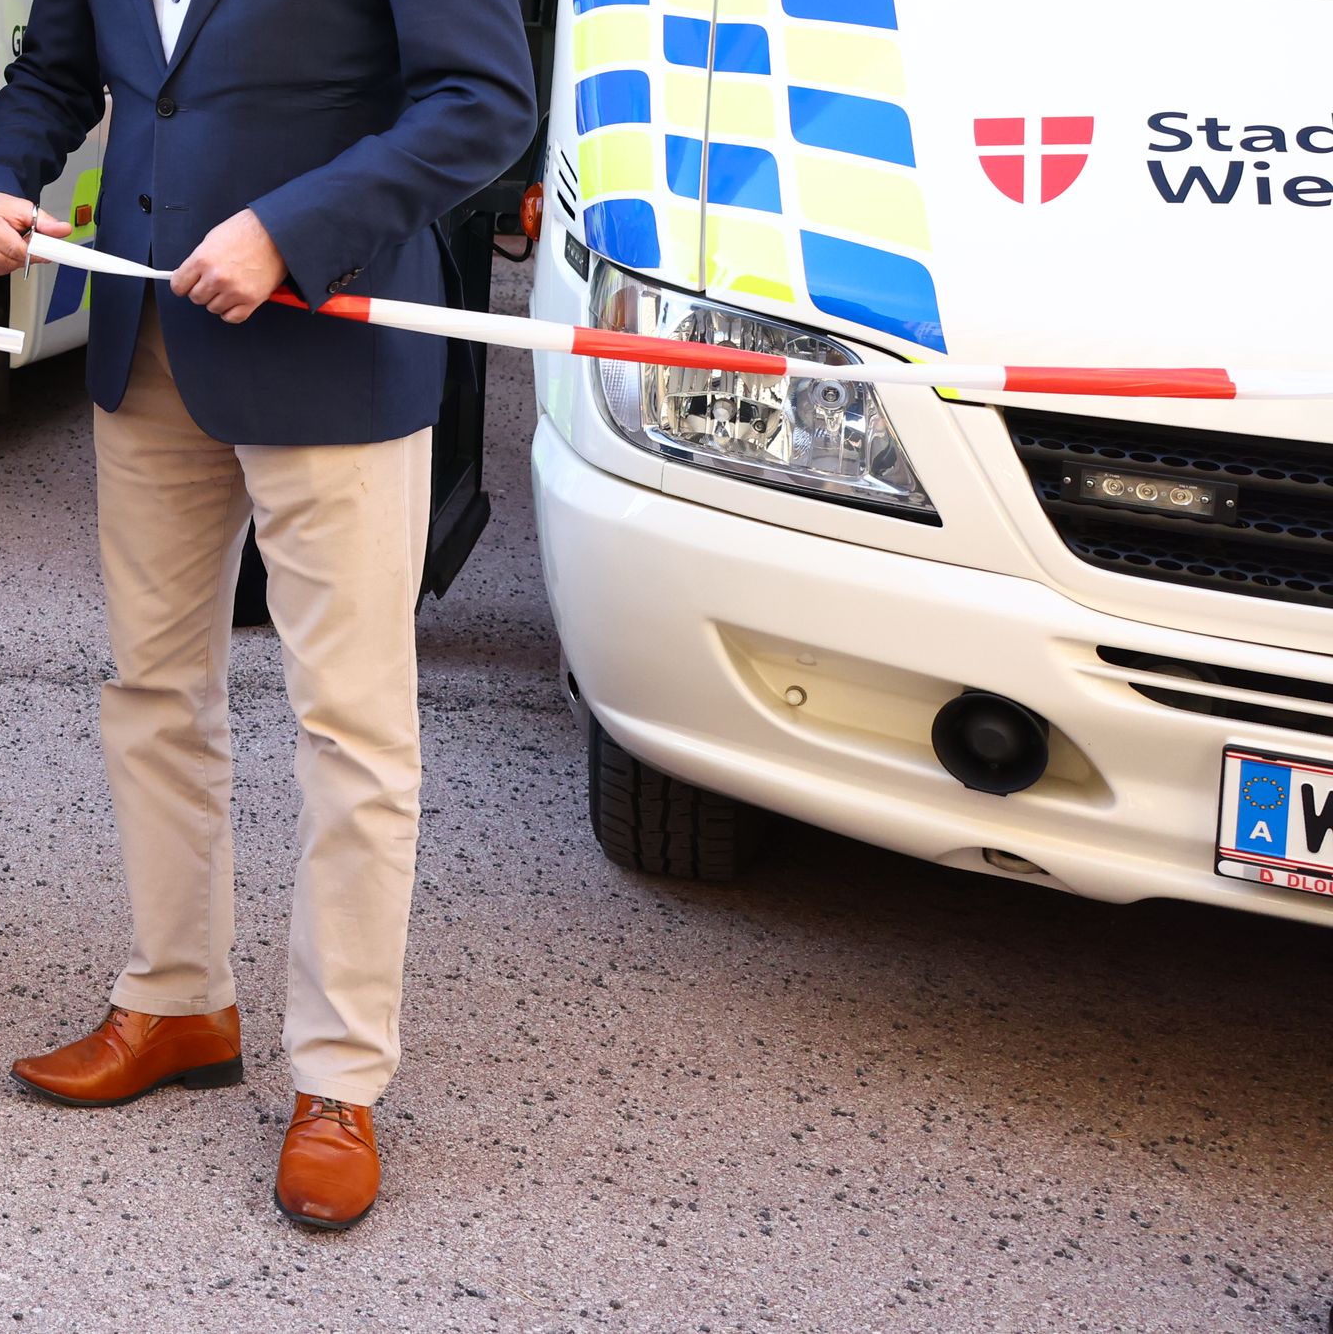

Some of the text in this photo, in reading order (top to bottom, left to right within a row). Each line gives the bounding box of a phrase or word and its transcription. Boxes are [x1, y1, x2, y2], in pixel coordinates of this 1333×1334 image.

[1146, 160, 1333, 207] Wie
[1249, 820, 1273, 843] A
[1287, 873, 1333, 894] DLO
